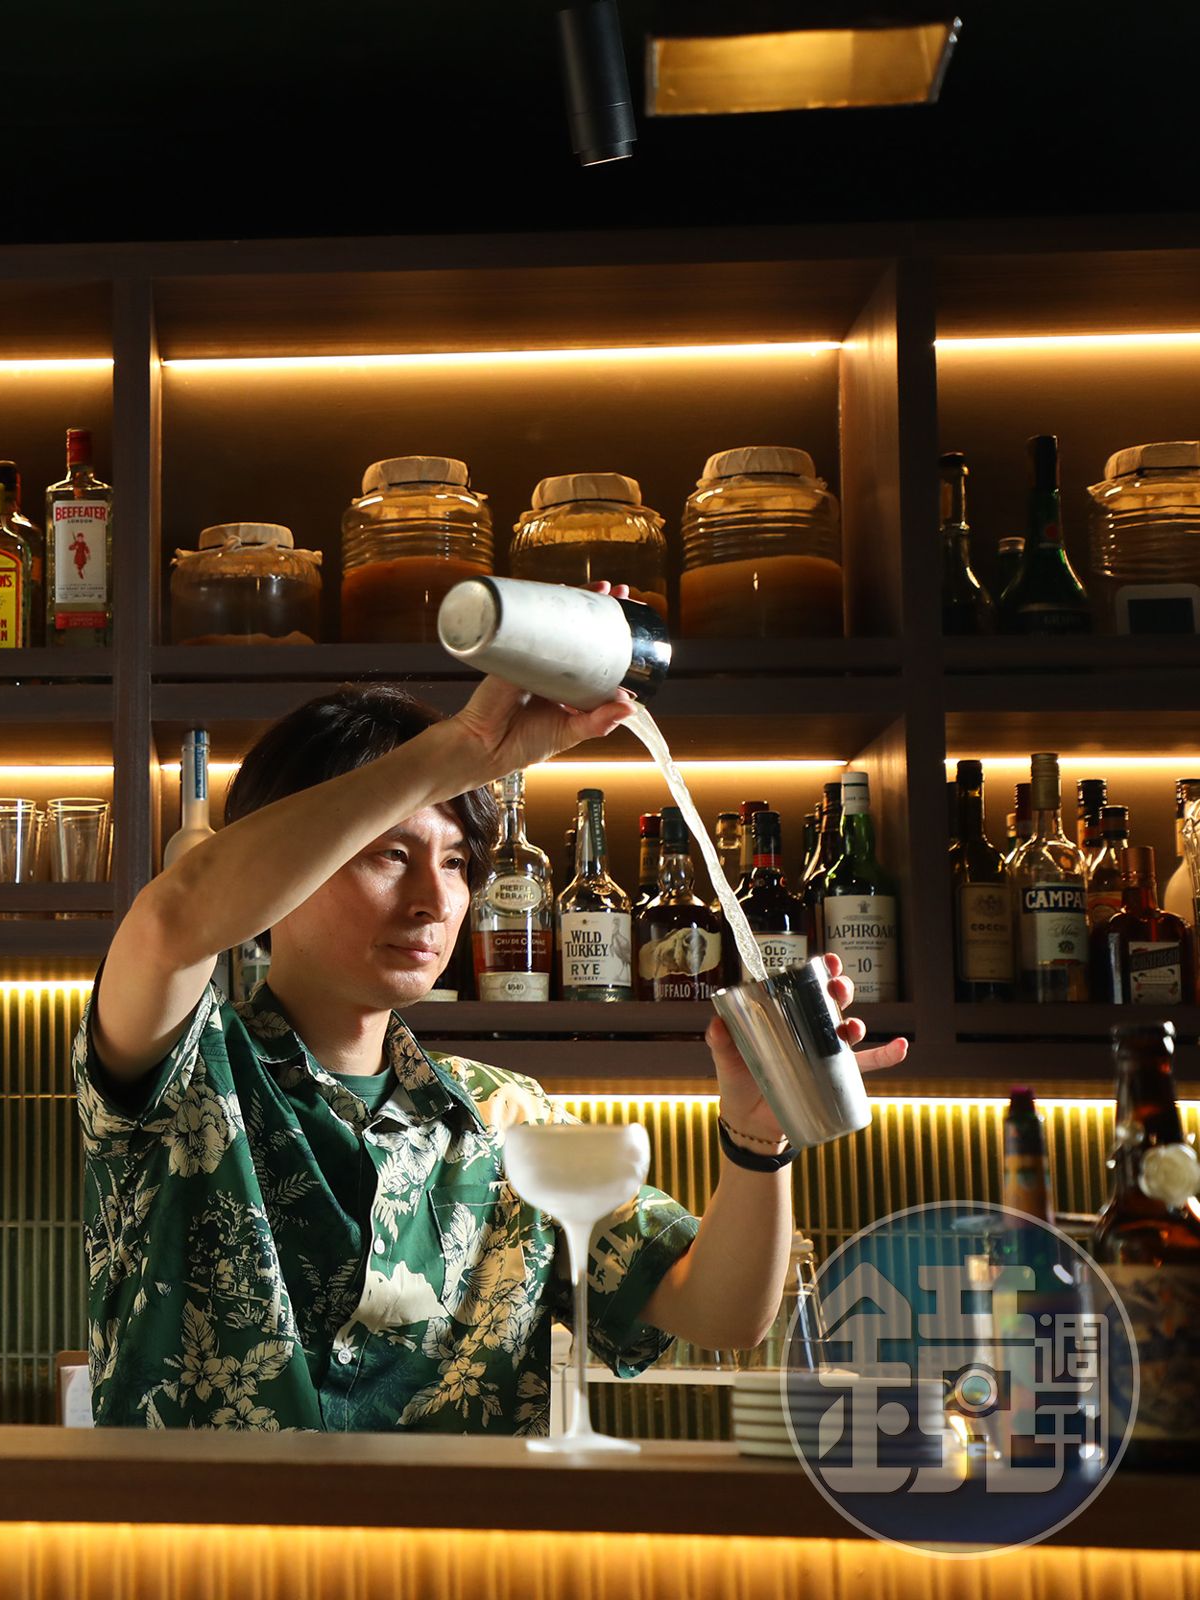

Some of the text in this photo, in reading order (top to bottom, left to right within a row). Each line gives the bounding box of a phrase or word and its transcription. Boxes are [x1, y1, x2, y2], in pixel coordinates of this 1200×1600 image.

[55, 506, 106, 521] BEEFEATER
[570, 930, 602, 943] WILD
[565, 941, 609, 958] TURKEY
[765, 945, 787, 955] OLD
[571, 964, 601, 976] RYE
[857, 958, 872, 973] 10
[654, 982, 690, 999] BUFFALO
